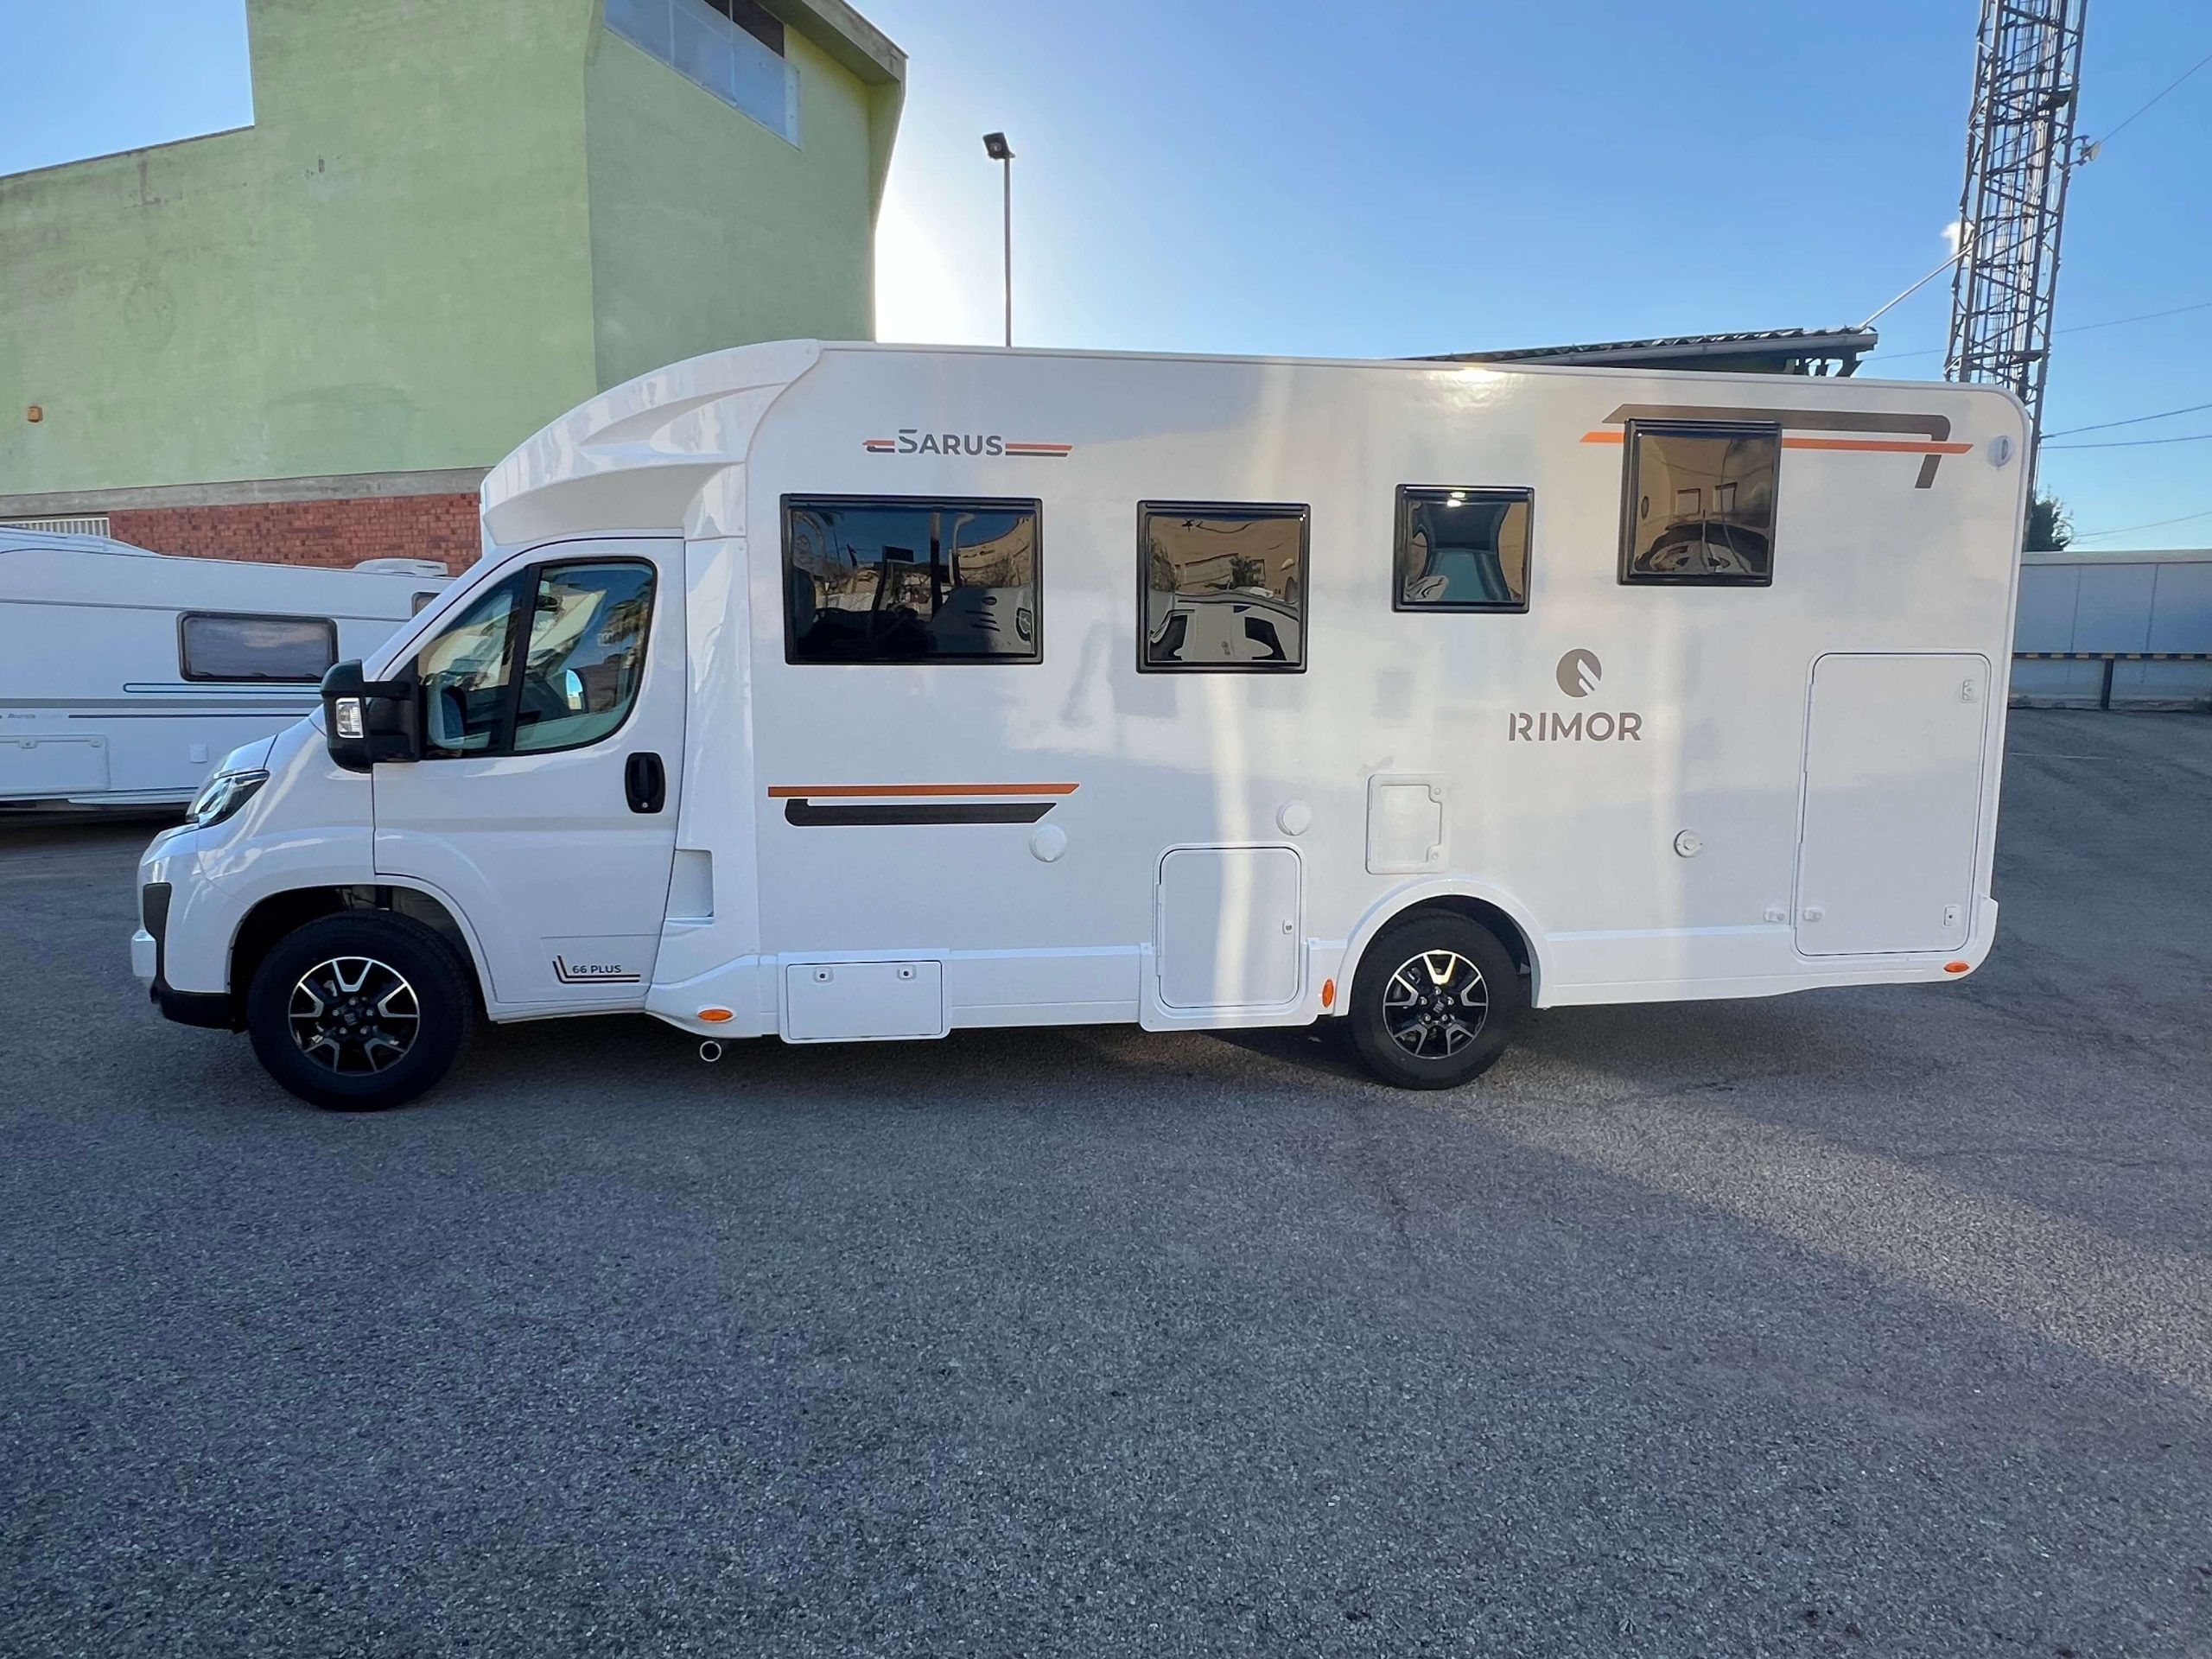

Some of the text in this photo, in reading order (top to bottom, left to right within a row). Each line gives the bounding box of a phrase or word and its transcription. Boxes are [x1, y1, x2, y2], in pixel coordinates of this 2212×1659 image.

[898, 429, 1003, 456] SARUS
[1509, 712, 1642, 741] RIMOR
[572, 964, 622, 974] 66 PLUS
